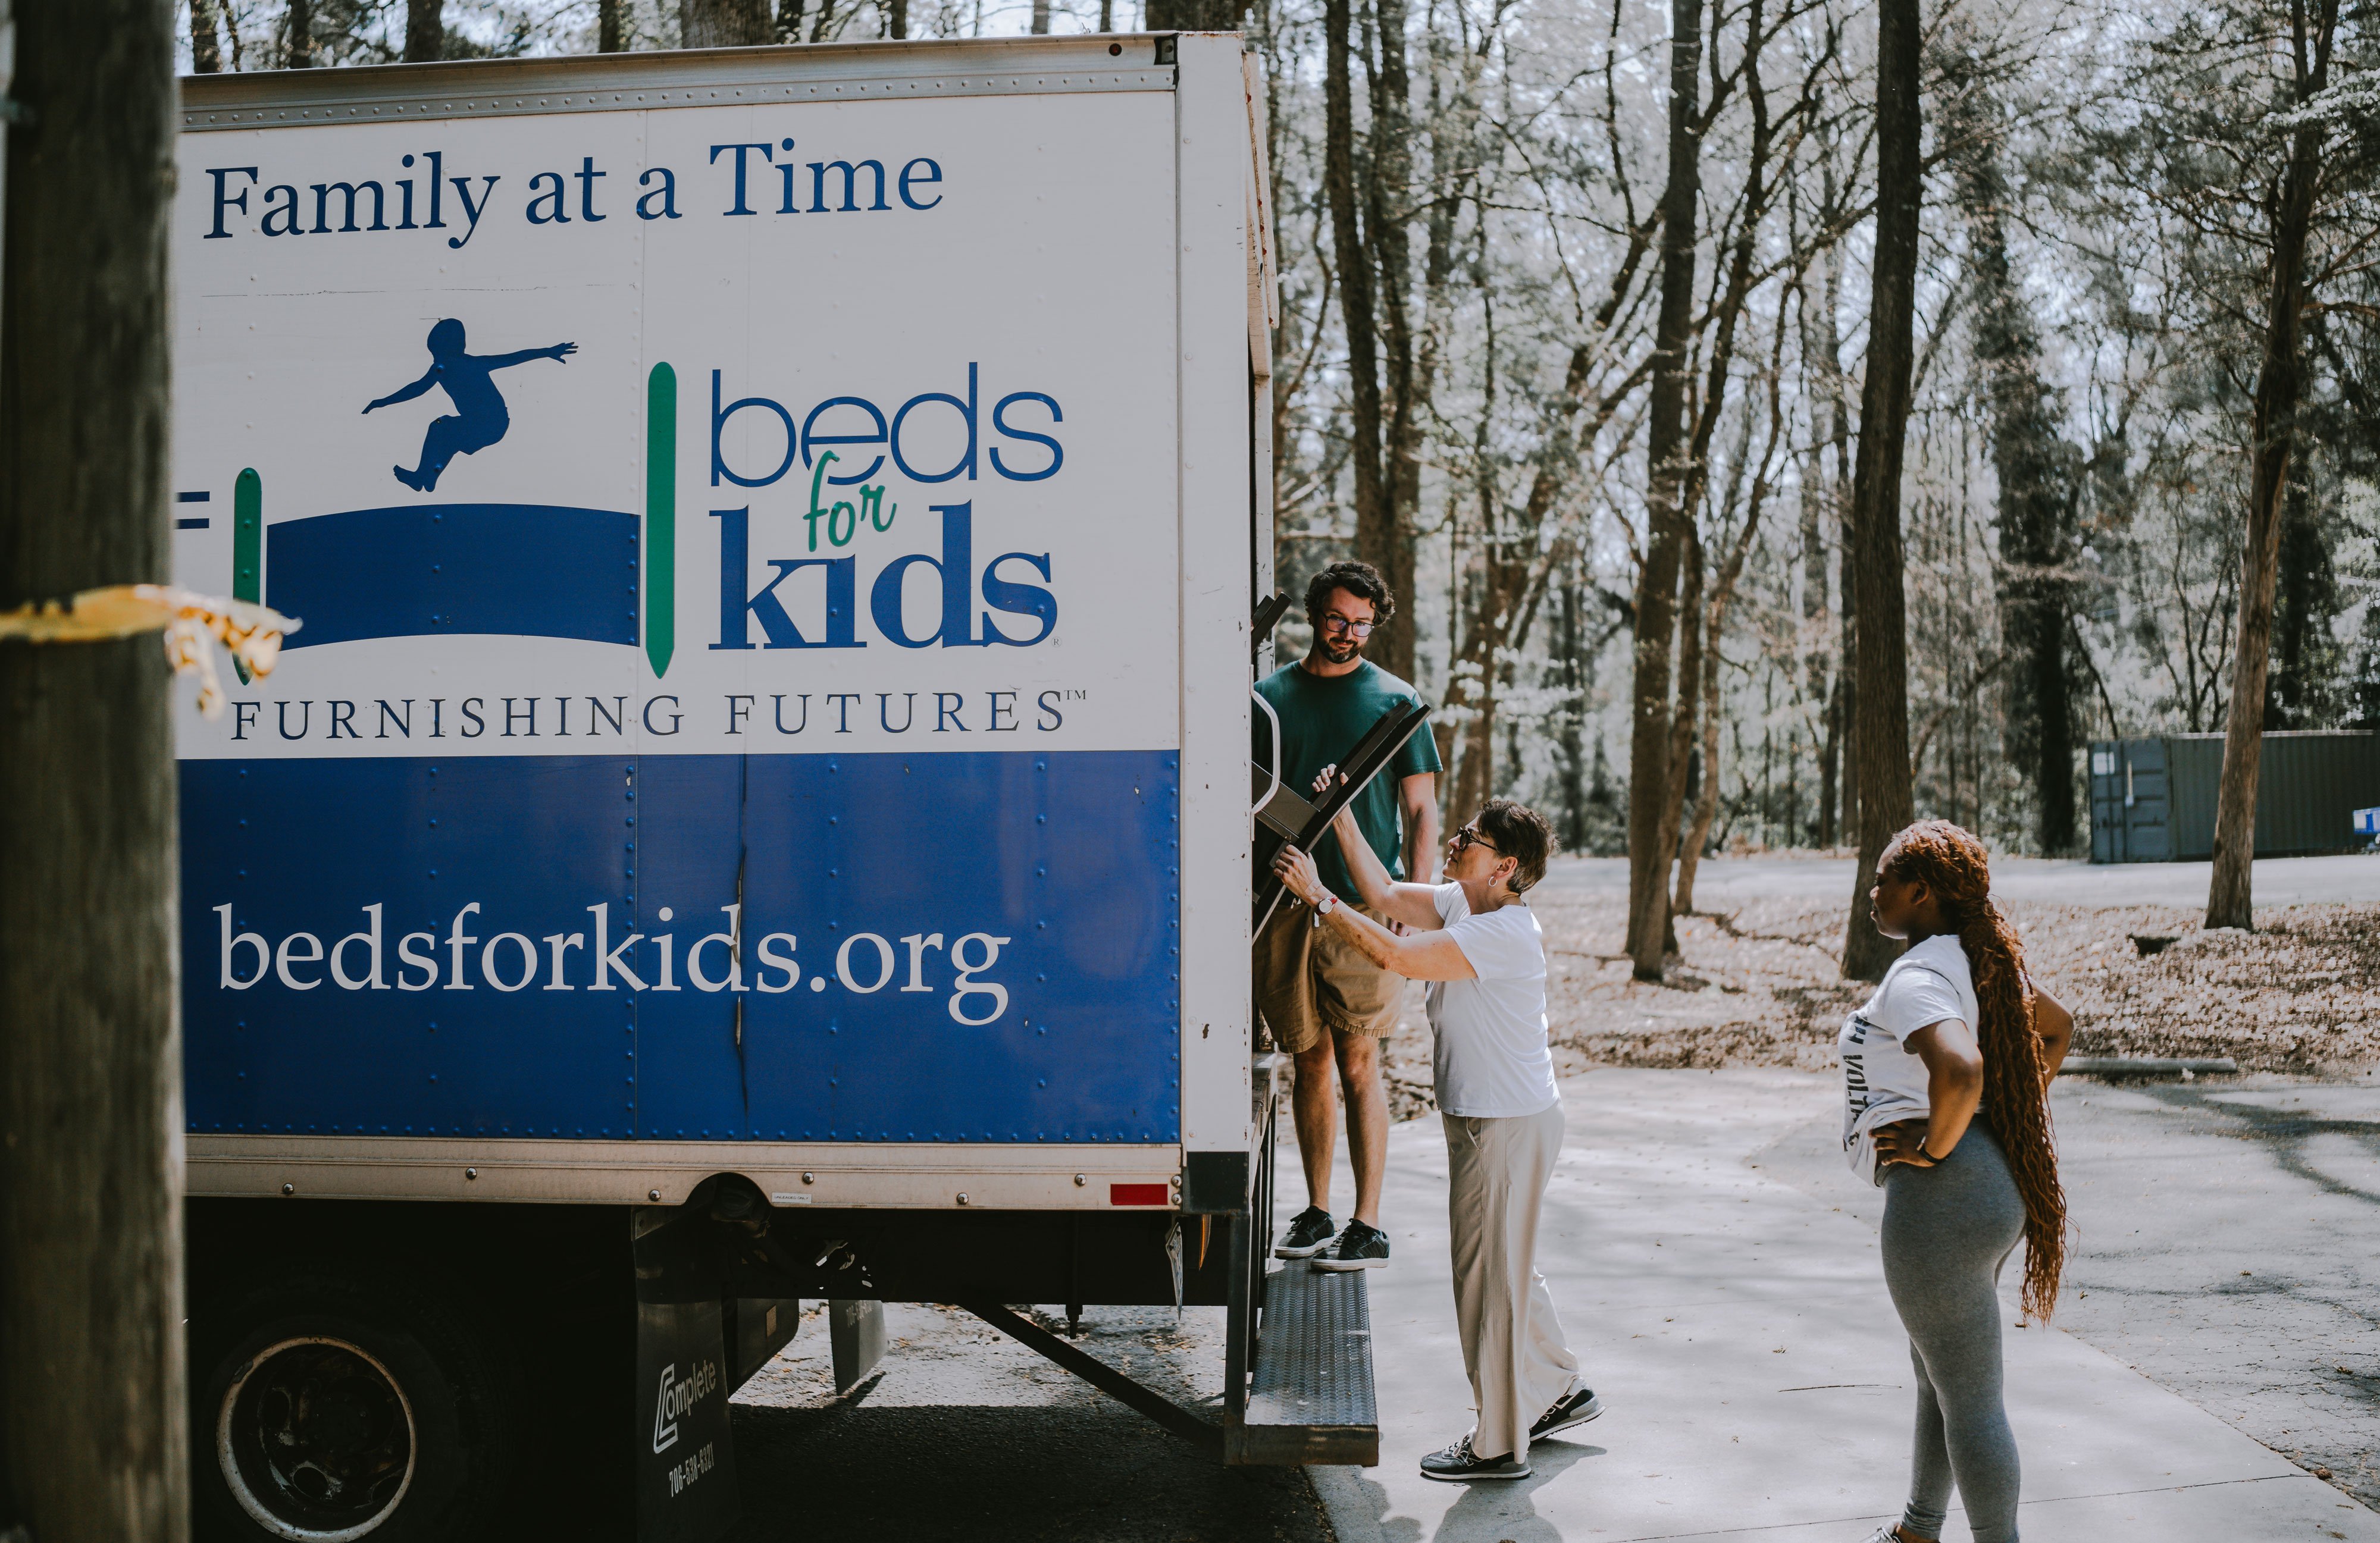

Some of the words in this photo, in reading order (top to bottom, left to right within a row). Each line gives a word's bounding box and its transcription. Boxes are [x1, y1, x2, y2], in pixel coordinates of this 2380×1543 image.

[203, 150, 501, 249] Family
[525, 156, 607, 225] at
[636, 167, 682, 221] a
[710, 137, 943, 217] Time
[710, 362, 1064, 488] beds
[803, 450, 897, 553] for
[230, 695, 685, 741] FURNISHING
[212, 902, 1012, 1025] bedsforkids.org
[653, 1359, 716, 1454] Complete
[669, 1441, 714, 1498] 706-538-6321
